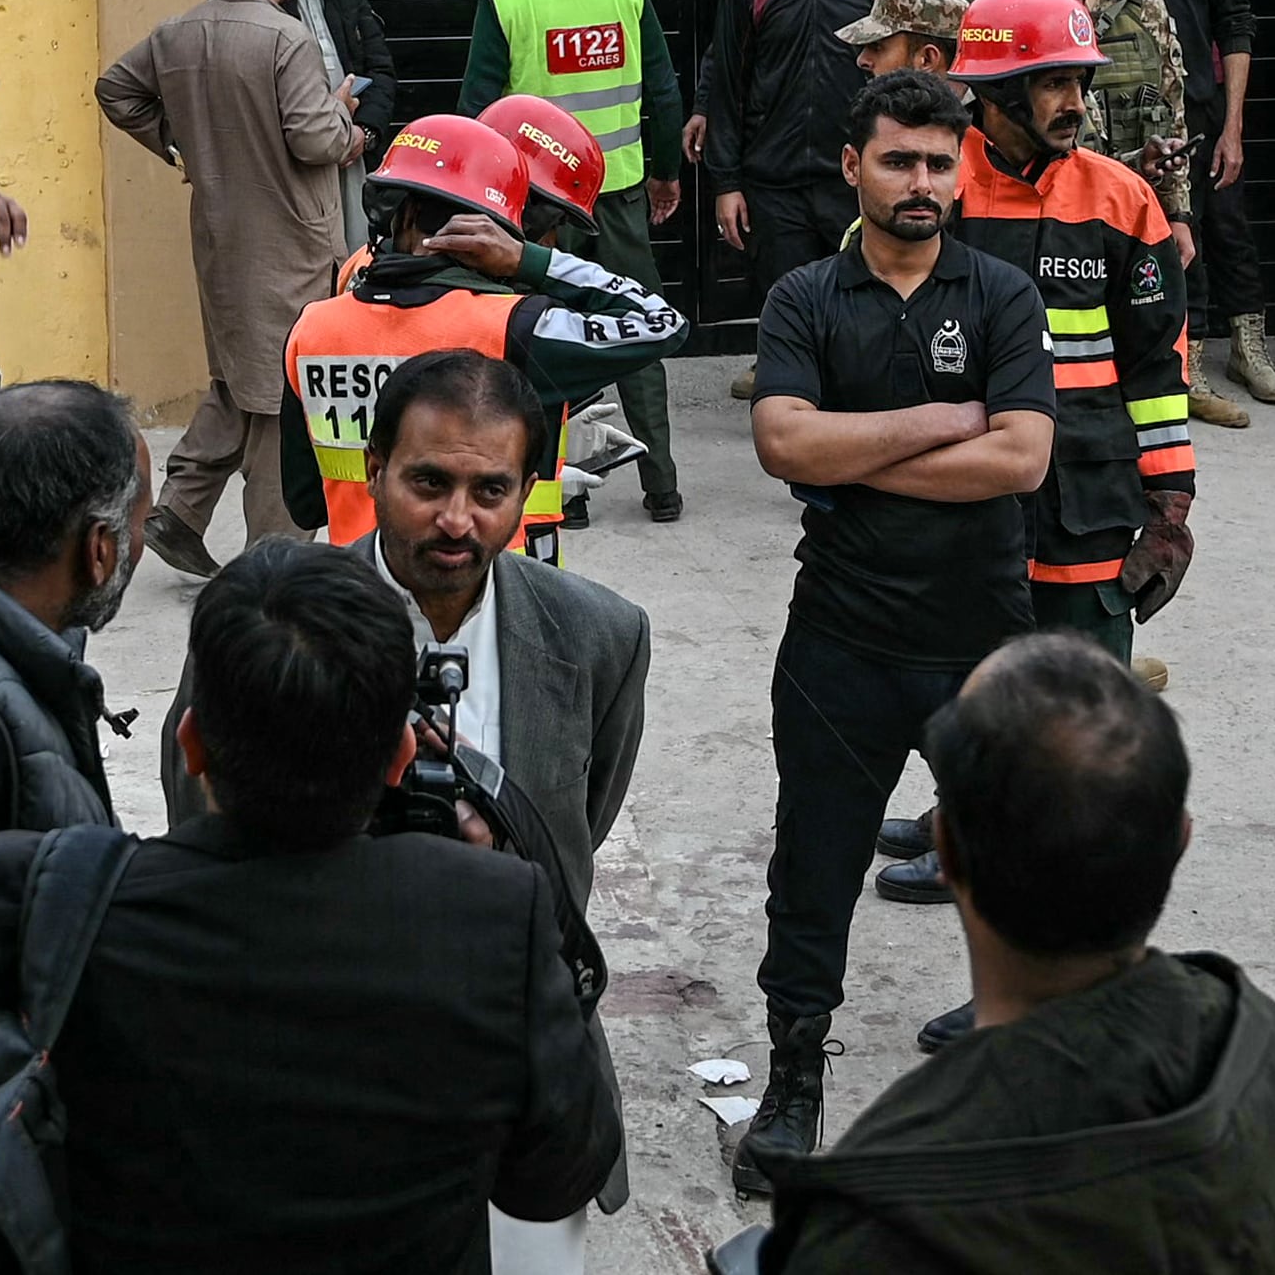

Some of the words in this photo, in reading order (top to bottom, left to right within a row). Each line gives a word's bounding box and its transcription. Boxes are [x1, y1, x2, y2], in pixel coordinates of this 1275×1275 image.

[552, 28, 620, 59] 1122
[961, 28, 1014, 43] RESCUE
[578, 52, 620, 68] CARES
[518, 122, 581, 172] RESCUE
[1038, 256, 1108, 280] RESCUE
[306, 363, 393, 399] RESC
[325, 405, 369, 441] 11
